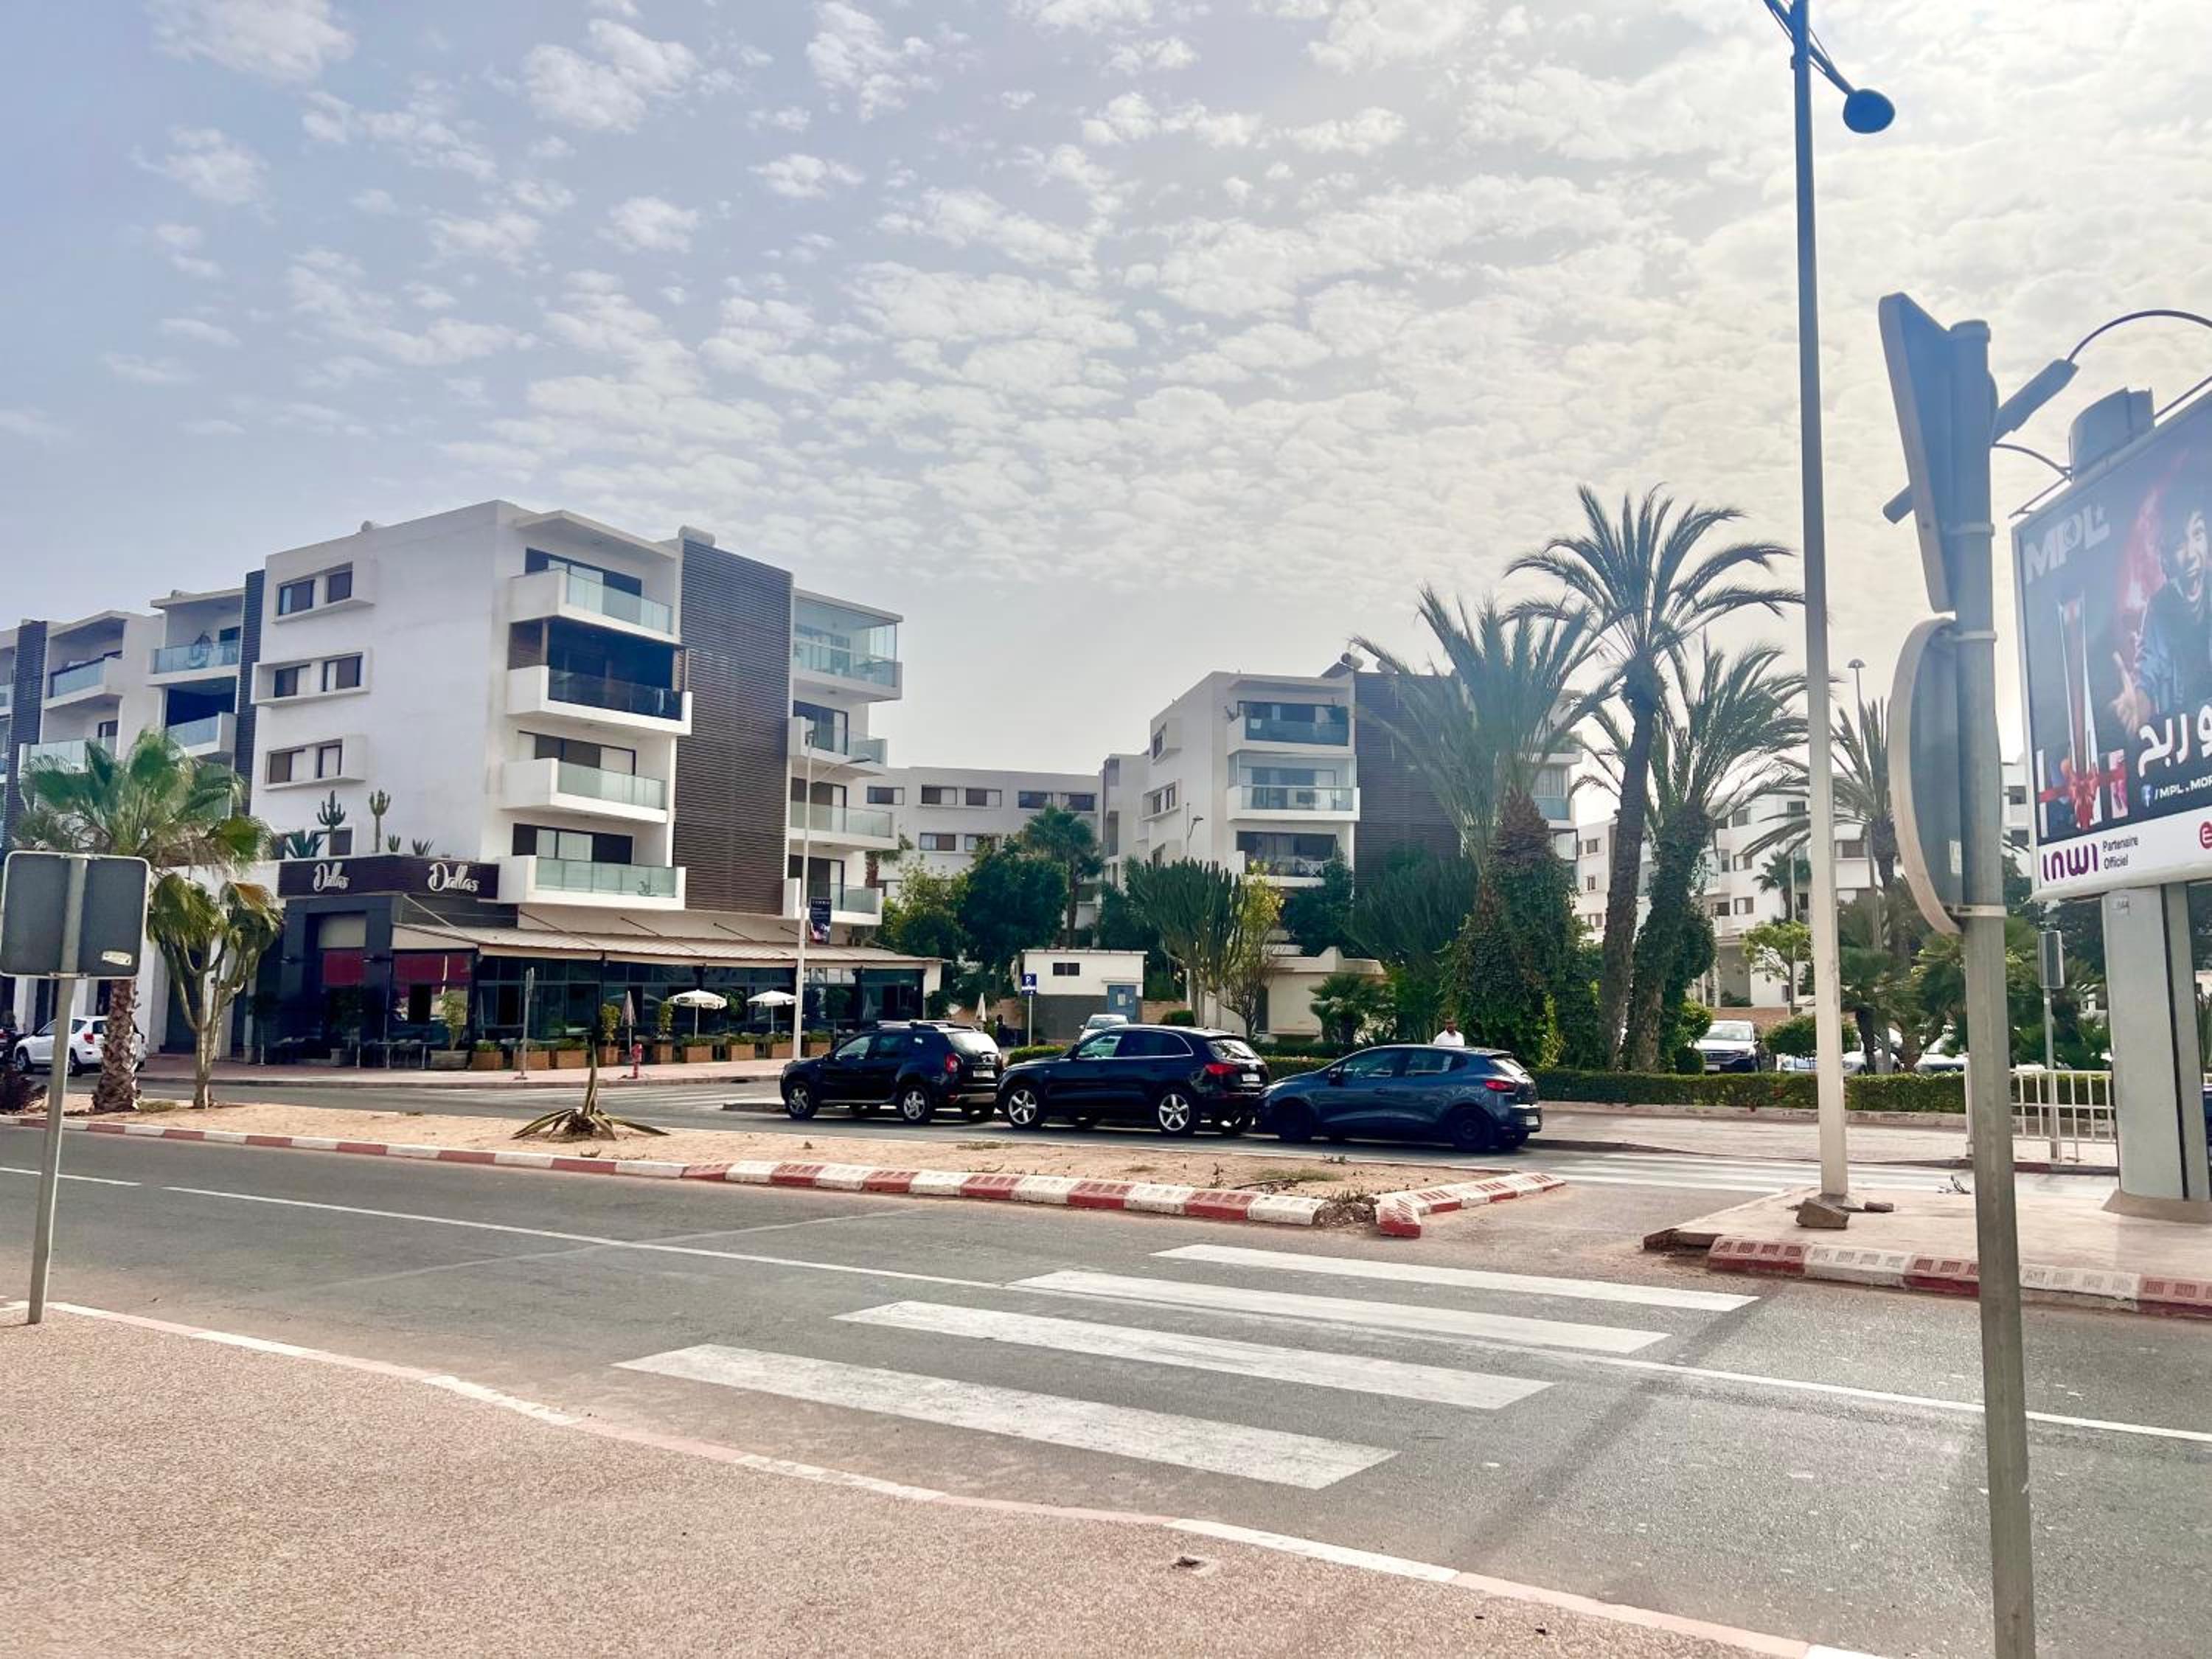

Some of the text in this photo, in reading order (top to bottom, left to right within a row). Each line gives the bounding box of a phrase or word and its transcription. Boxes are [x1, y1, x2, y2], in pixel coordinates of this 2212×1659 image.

[2102, 836, 2138, 852] Partenaire
[2104, 855, 2129, 869] Officiel
[313, 862, 349, 891] Dallas
[428, 862, 479, 892] Dallas
